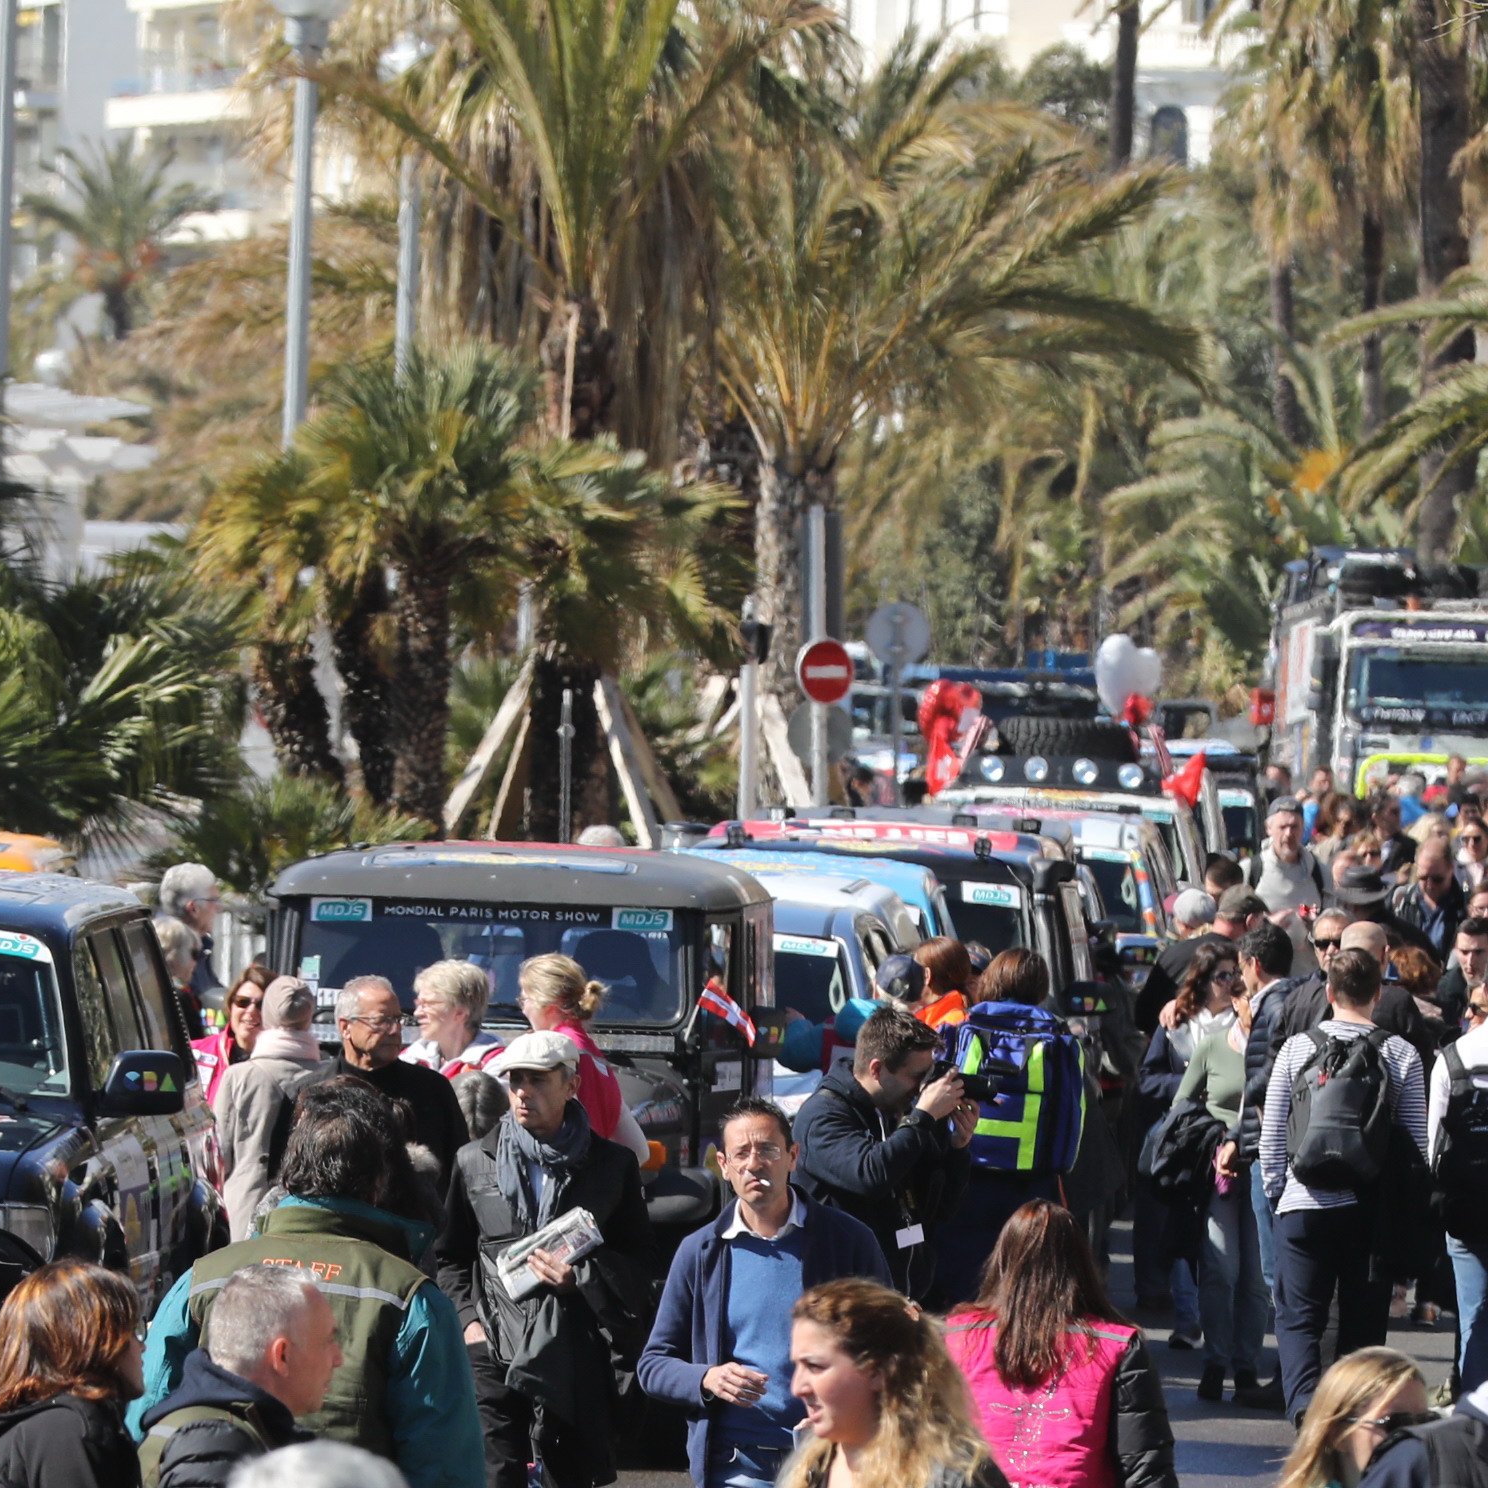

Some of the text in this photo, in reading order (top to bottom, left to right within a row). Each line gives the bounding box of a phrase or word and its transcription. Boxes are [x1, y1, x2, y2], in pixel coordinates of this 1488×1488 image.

[974, 890, 1010, 903] MDJS
[319, 904, 363, 917] MDJS
[384, 904, 601, 924] MONDIAL PARIS MOTOR SHOW
[621, 912, 666, 926] MDJS
[123, 1070, 179, 1093] CBA
